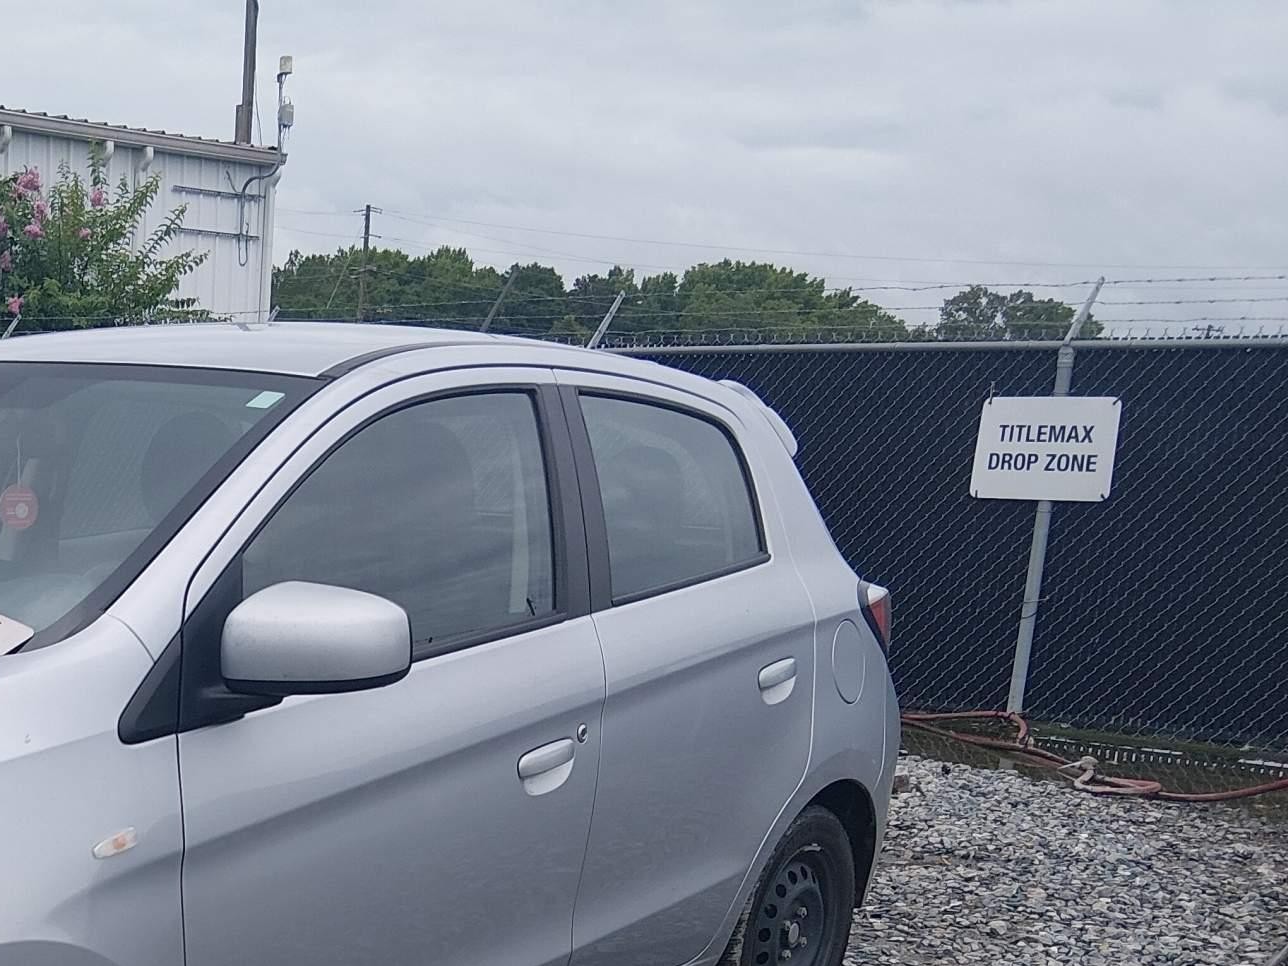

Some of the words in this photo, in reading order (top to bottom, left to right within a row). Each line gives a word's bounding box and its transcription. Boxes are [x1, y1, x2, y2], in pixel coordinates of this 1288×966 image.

[999, 424, 1095, 443] TITLEMAX
[987, 452, 1039, 471] DROP
[1043, 453, 1099, 472] ZONE
